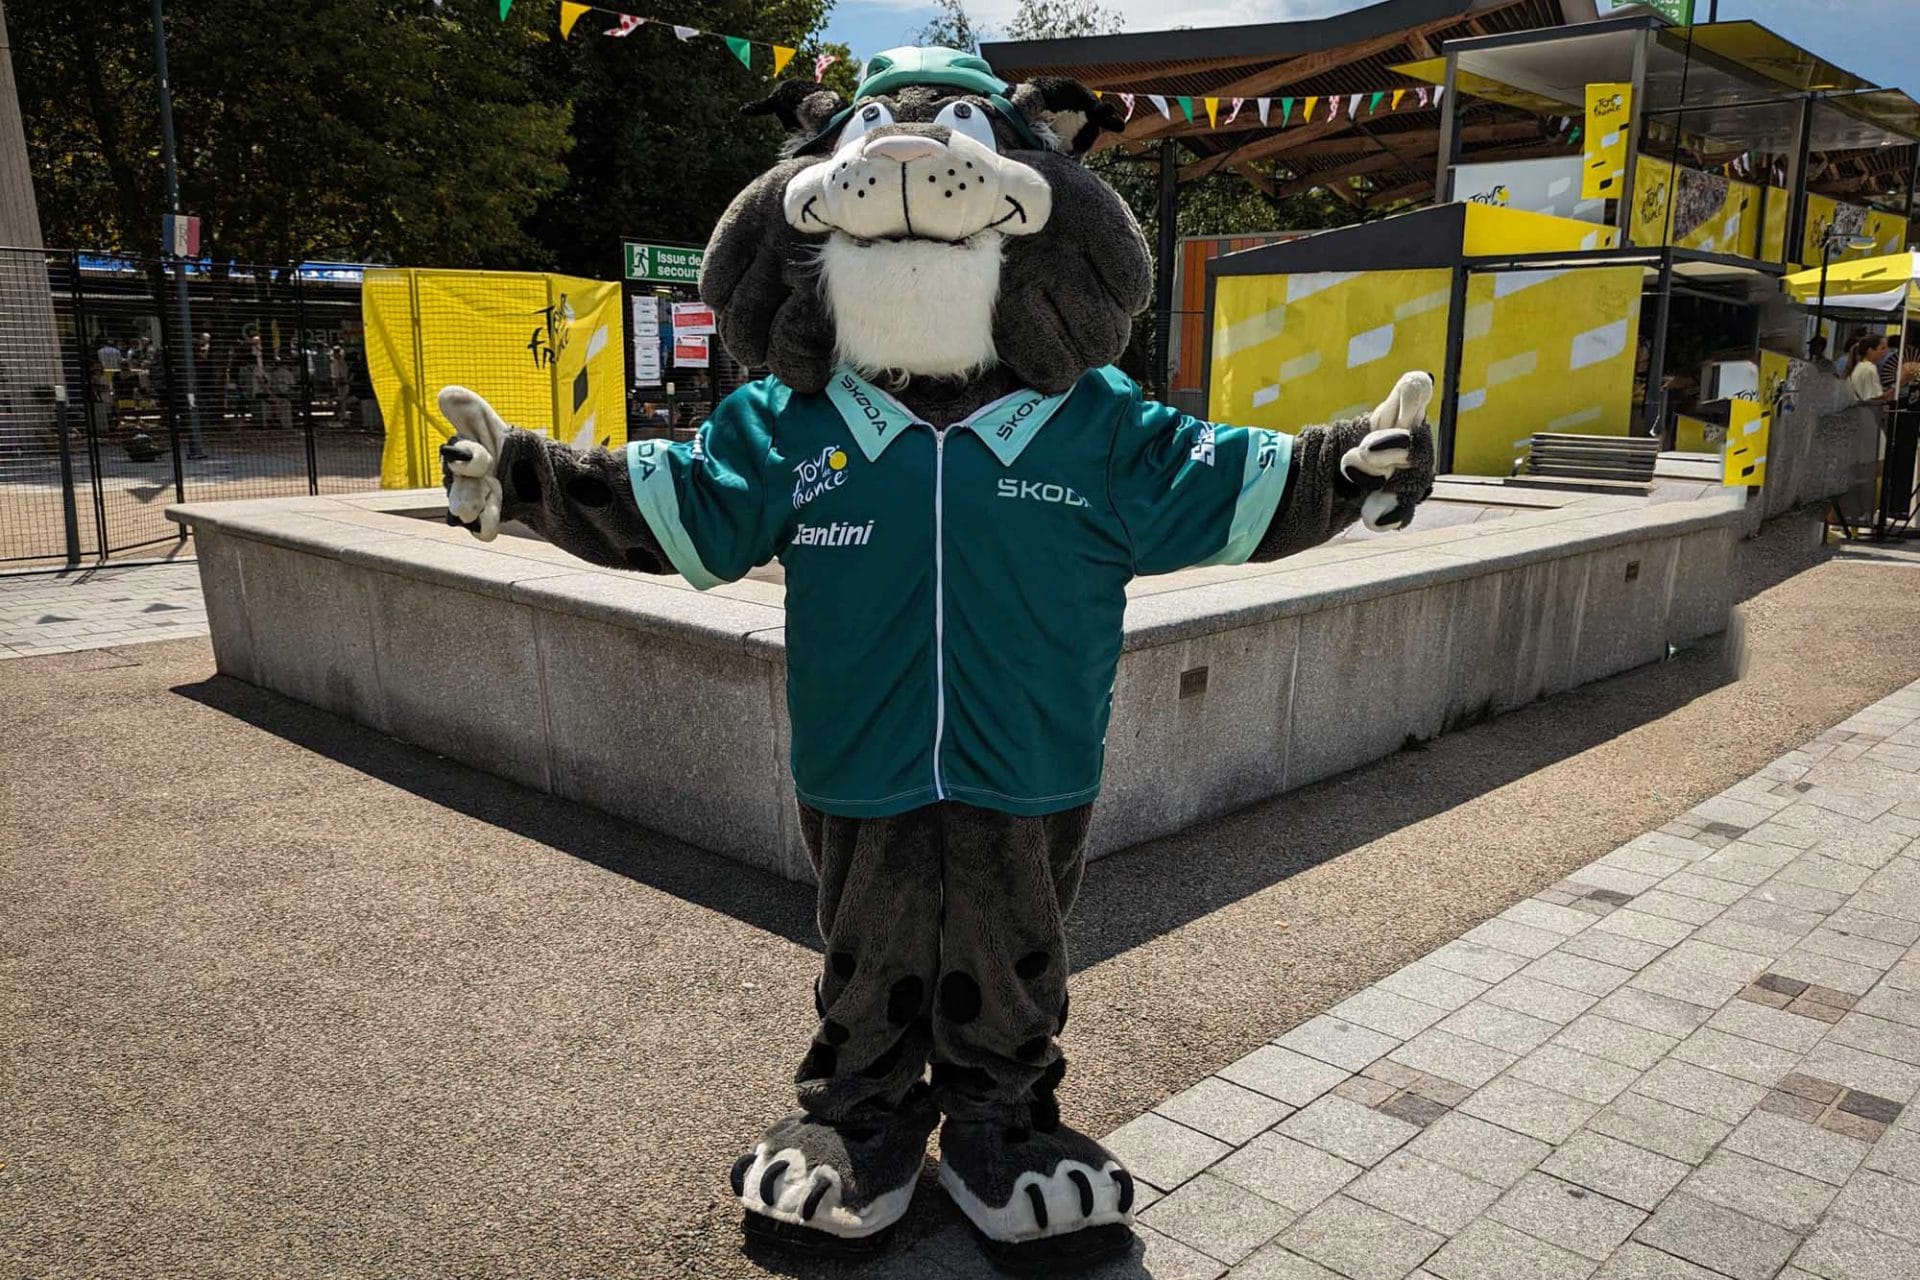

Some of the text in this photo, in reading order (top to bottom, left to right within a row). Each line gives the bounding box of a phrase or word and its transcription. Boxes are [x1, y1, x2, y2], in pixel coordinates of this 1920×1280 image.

[657, 250, 701, 266] Issue de
[657, 266, 702, 278] secours
[997, 478, 1094, 508] SKOD
